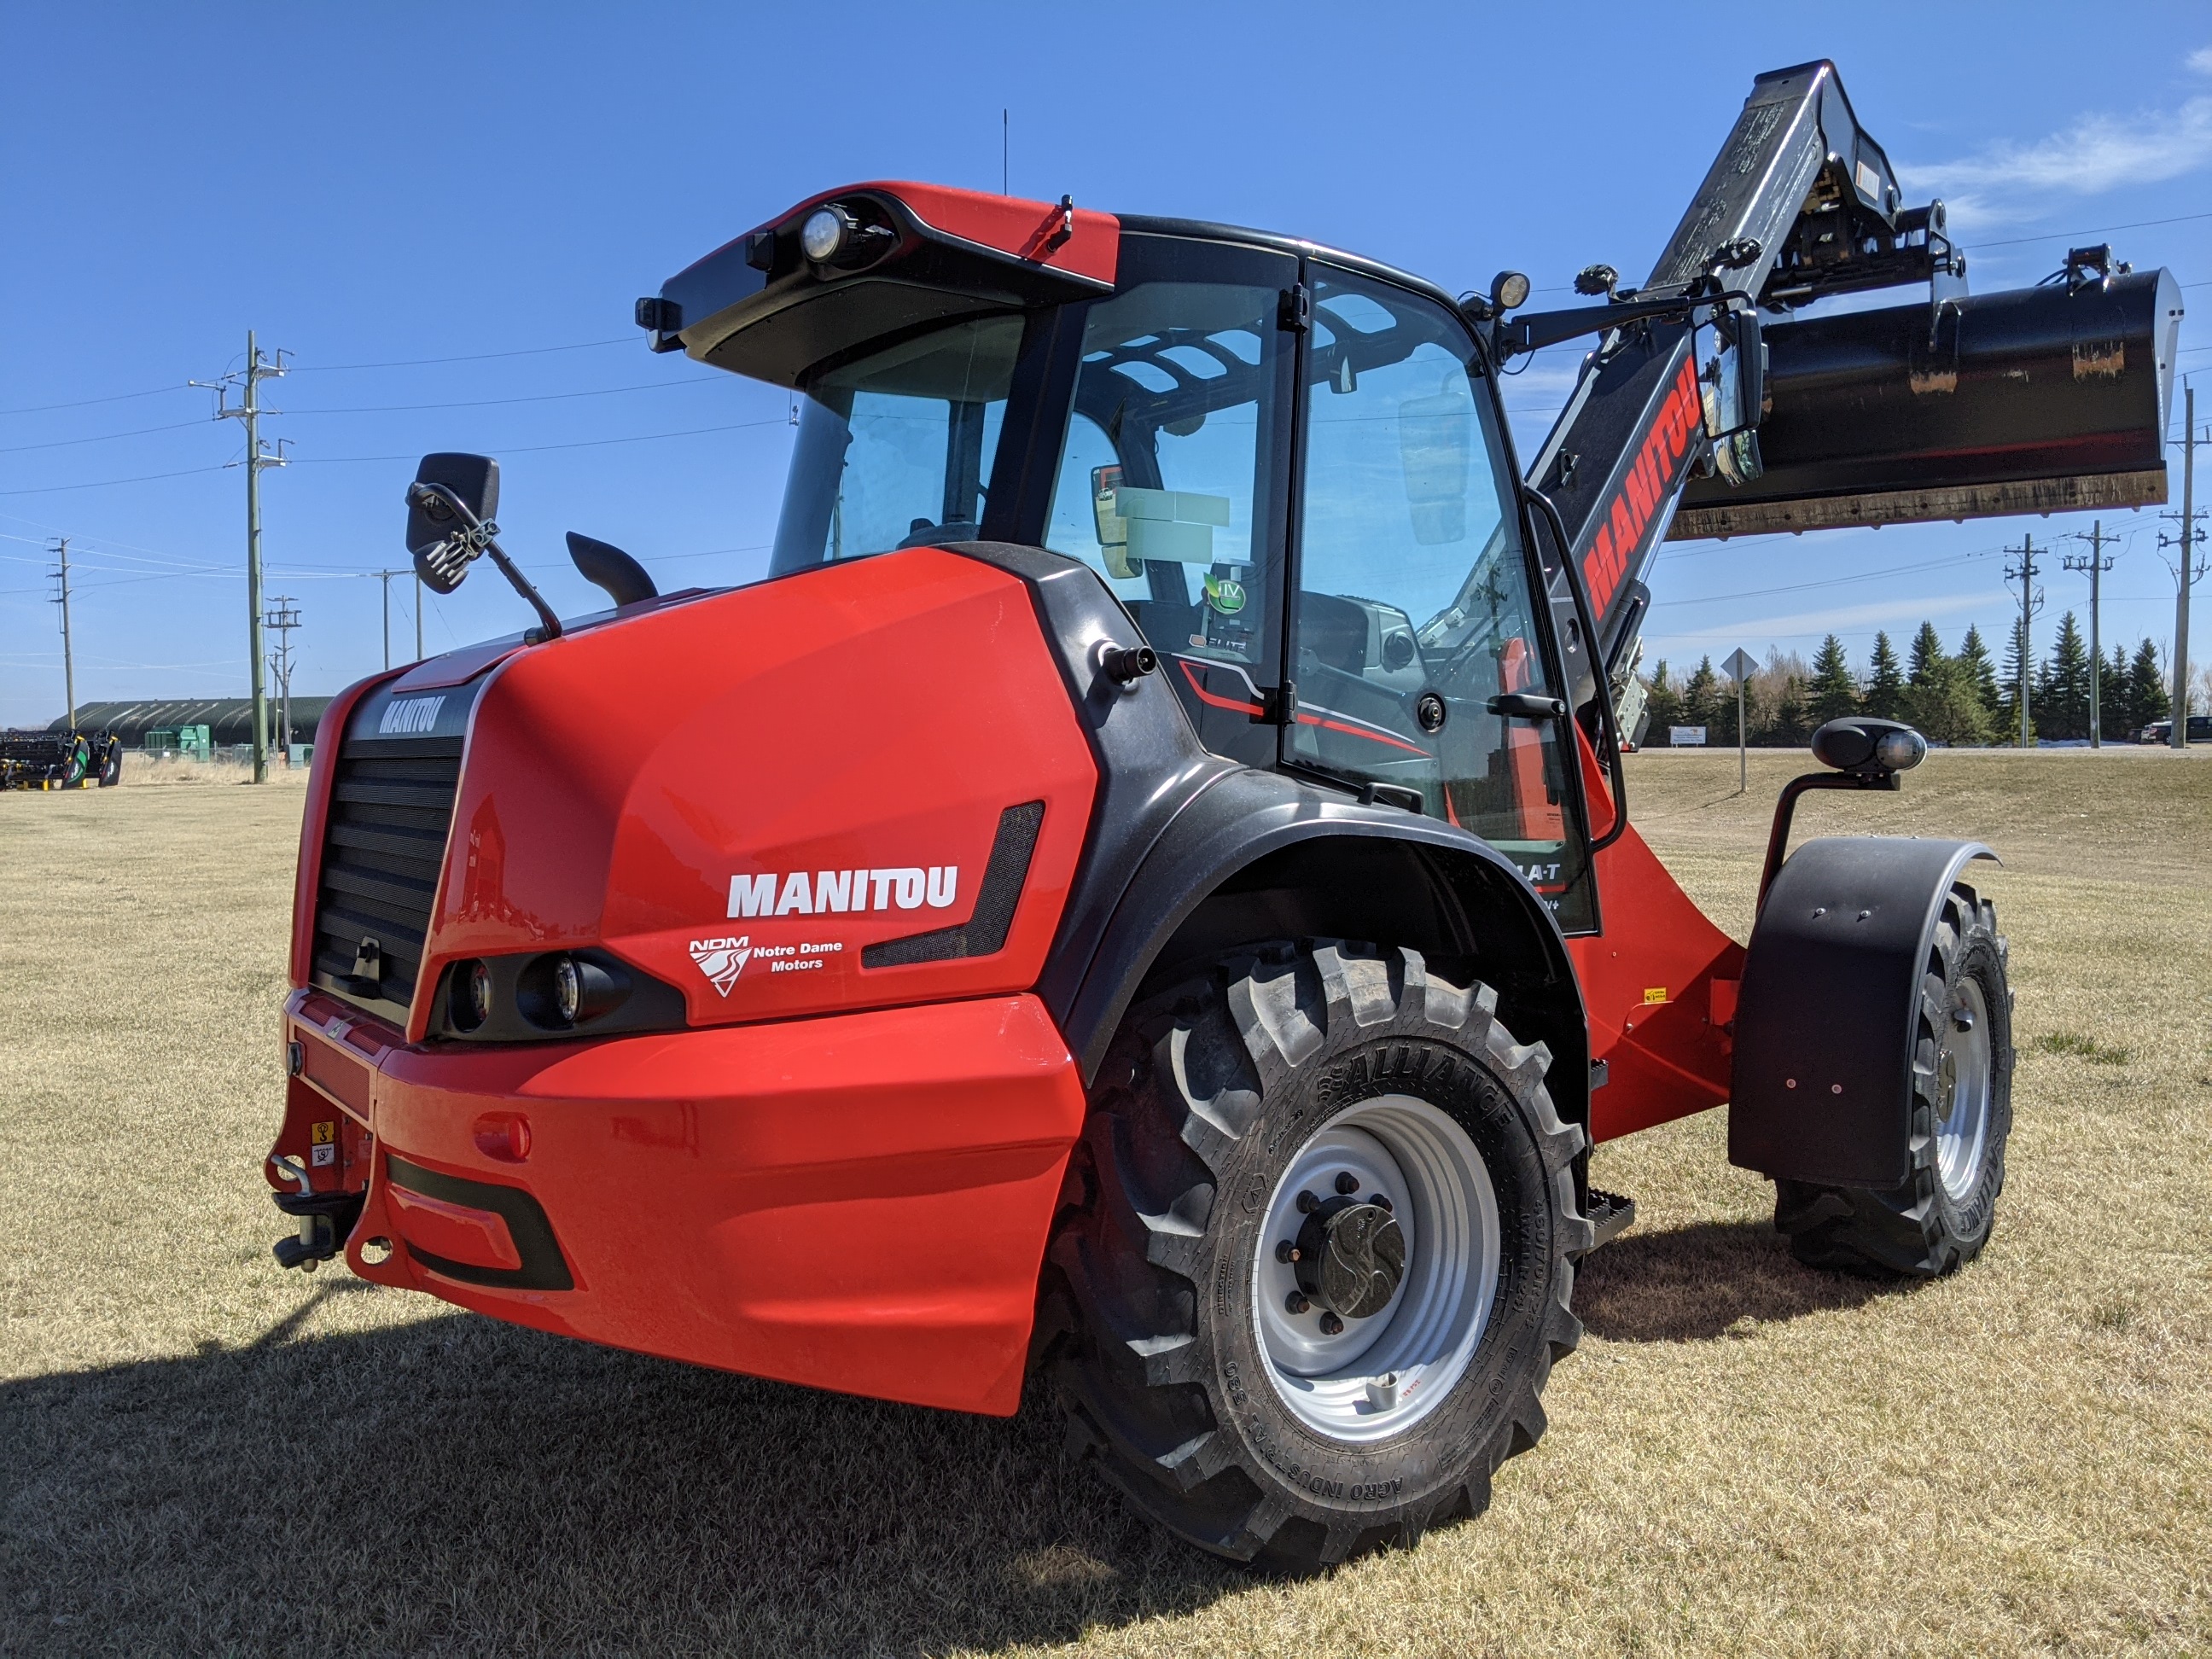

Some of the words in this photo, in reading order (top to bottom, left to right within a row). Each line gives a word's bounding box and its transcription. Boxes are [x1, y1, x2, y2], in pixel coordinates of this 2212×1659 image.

[1583, 354, 1702, 622] MANITOU
[379, 696, 447, 734] MANITOU
[727, 865, 958, 918] MANITOU
[689, 935, 749, 952] NDM
[753, 946, 795, 958] Notre
[800, 941, 843, 955] Dame
[771, 959, 824, 973] Motors
[1344, 1045, 1517, 1130] ALLIANCE
[1223, 1361, 1248, 1406] 580
[1350, 1476, 1404, 1500] AGRO
